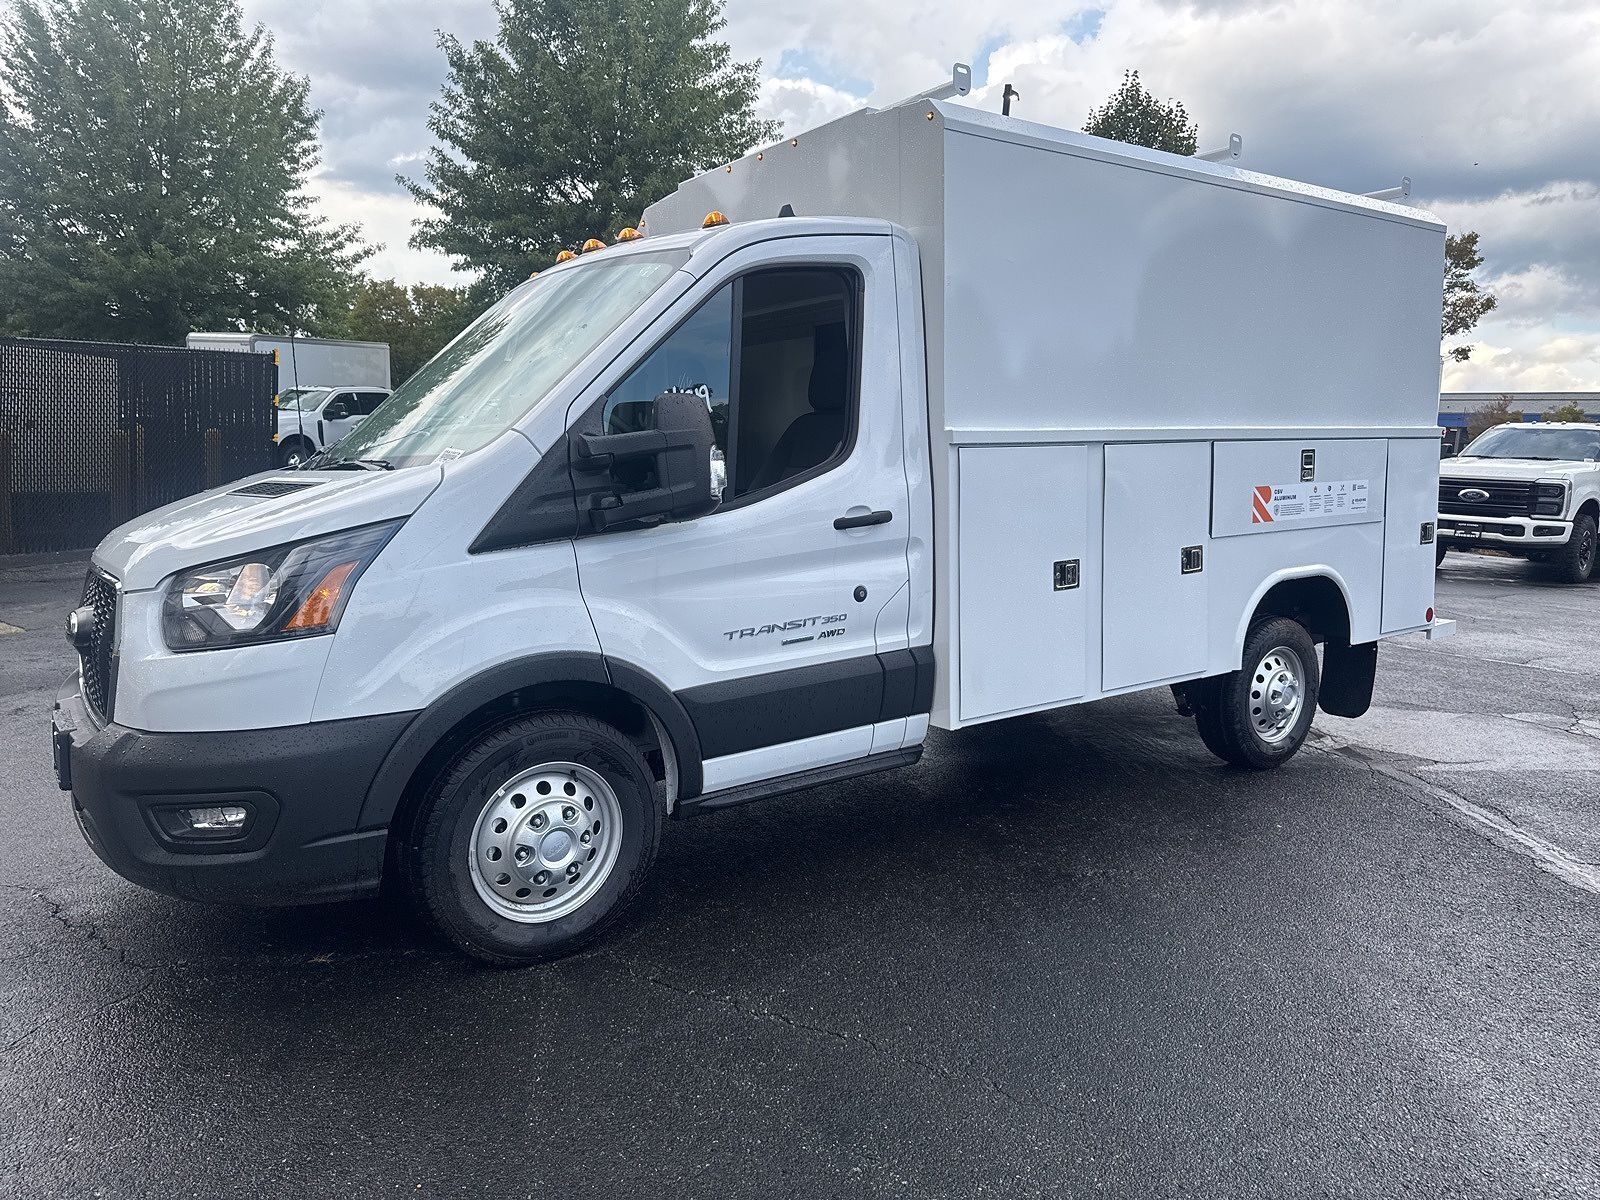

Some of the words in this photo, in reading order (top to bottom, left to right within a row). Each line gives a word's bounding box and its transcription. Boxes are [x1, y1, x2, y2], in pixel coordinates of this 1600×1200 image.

[723, 615, 822, 641] TRANSIT
[821, 613, 848, 625] 350
[817, 627, 846, 641] AWD
